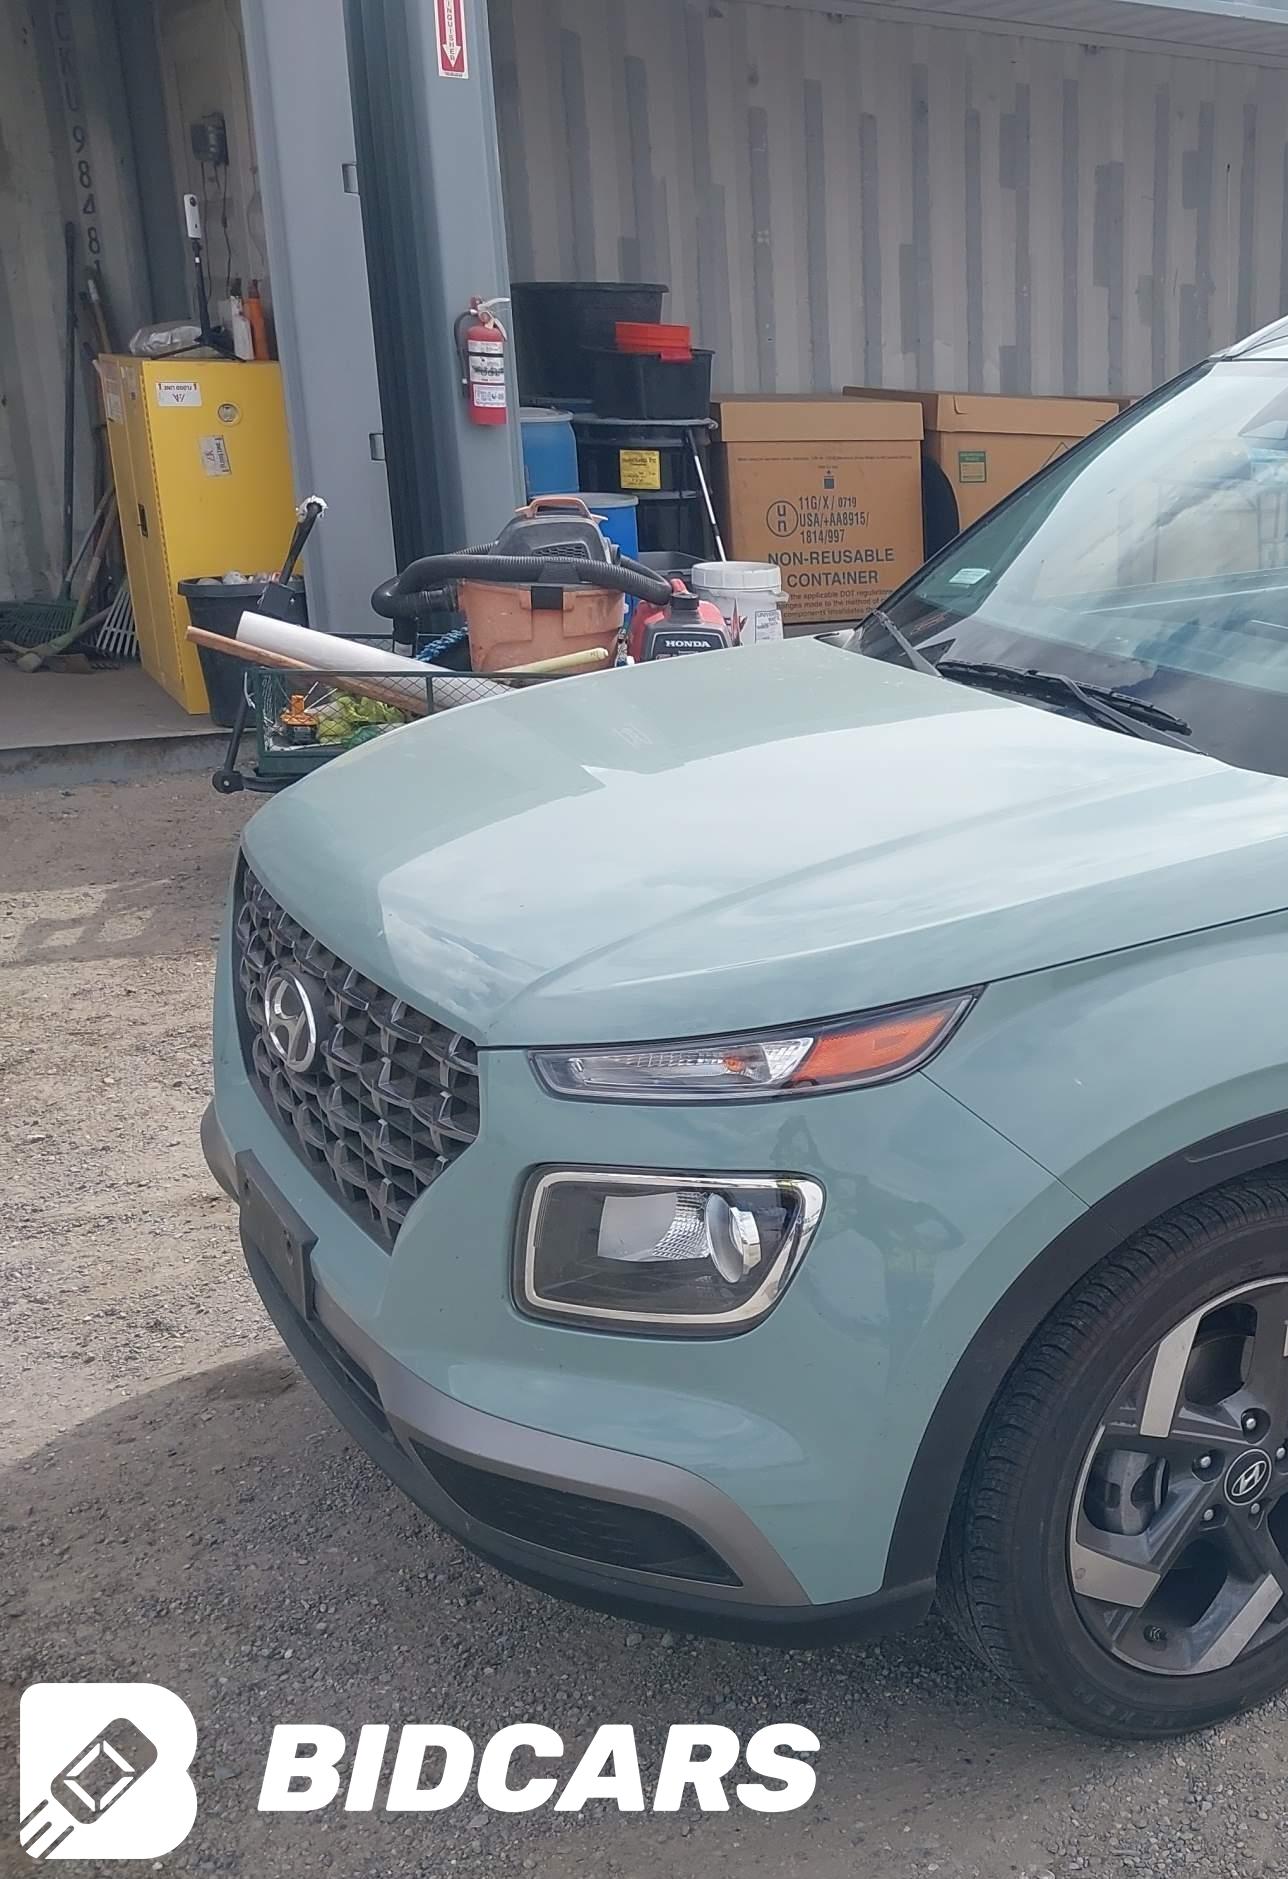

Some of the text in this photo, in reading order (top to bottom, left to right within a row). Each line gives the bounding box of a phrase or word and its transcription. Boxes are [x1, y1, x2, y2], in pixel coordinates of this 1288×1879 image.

[800, 512, 870, 528] USA/+AA8915/
[800, 529, 845, 544] 1814/997
[768, 548, 895, 566] NON-REUSABLE
[787, 570, 879, 588] CONTAINER
[665, 640, 711, 648] HONDA
